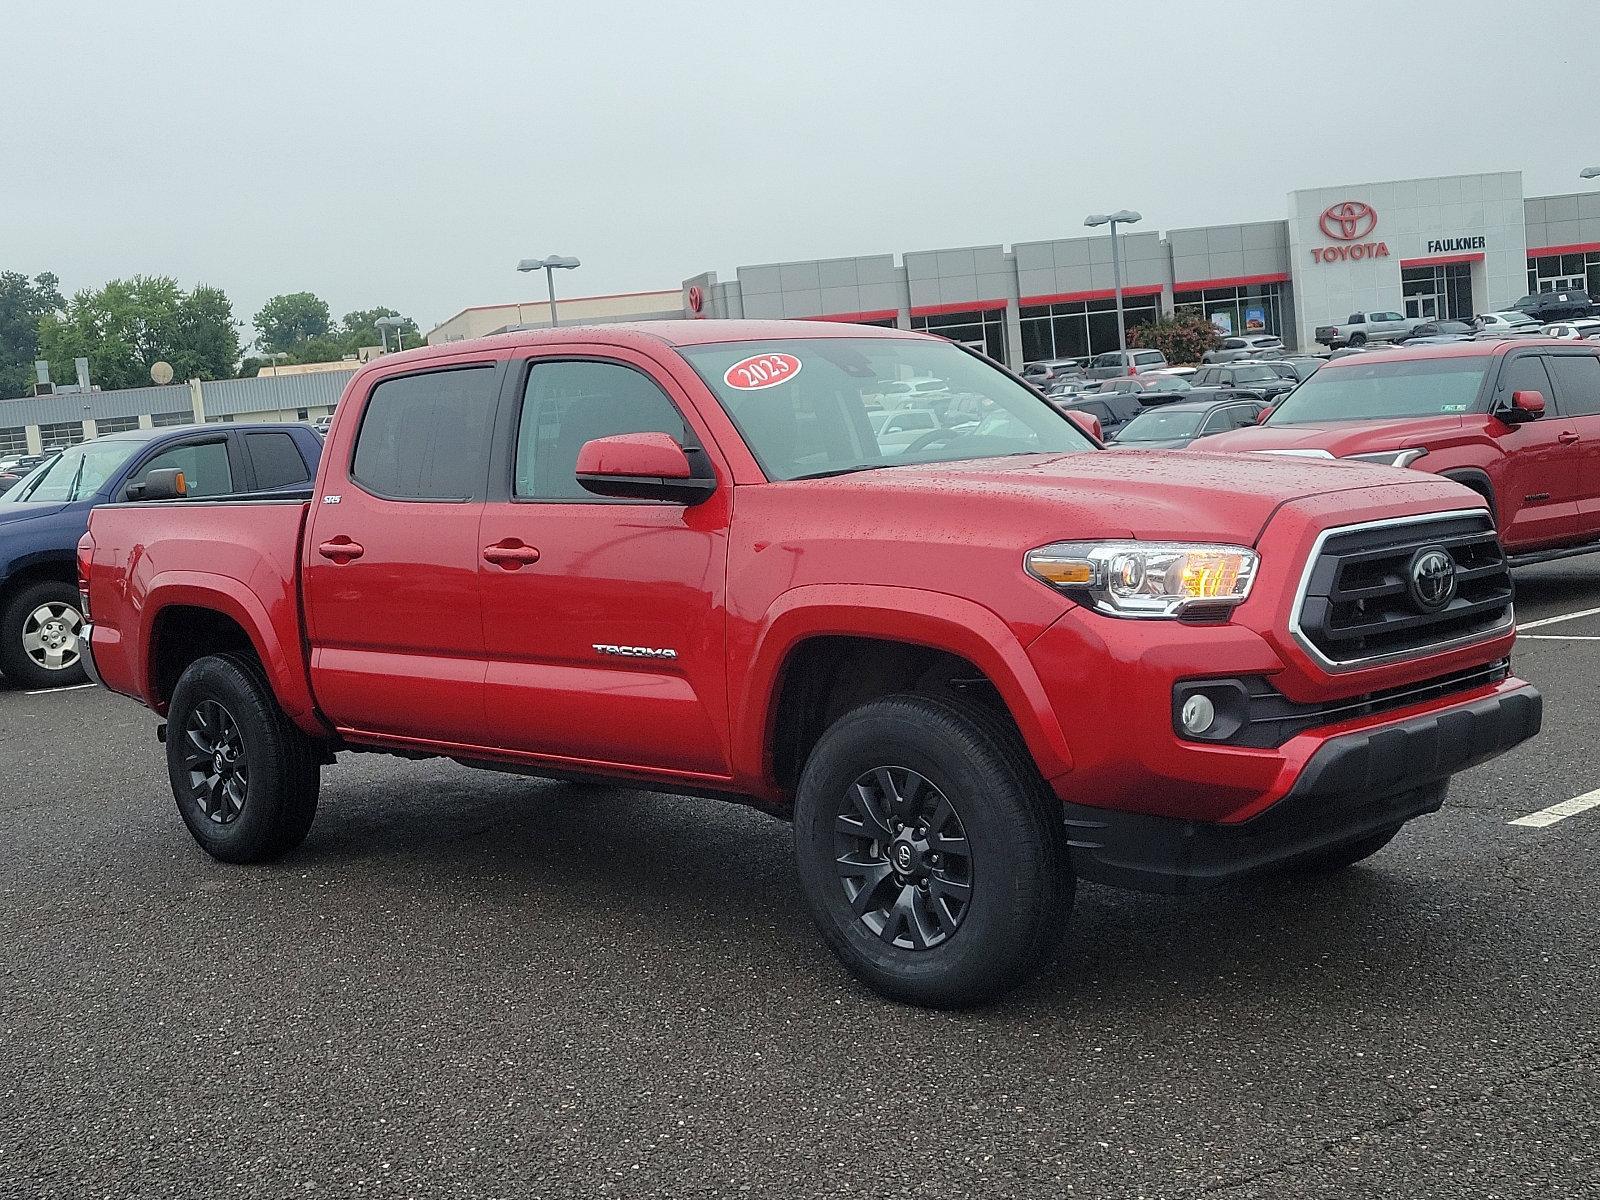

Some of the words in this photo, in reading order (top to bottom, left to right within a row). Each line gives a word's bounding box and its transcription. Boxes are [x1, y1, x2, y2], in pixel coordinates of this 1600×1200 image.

[1311, 242, 1390, 263] TOYOTA
[1428, 236, 1486, 253] FAULKNER
[738, 355, 789, 387] 2023
[323, 495, 342, 504] SR5
[592, 644, 678, 659] TACOMA
